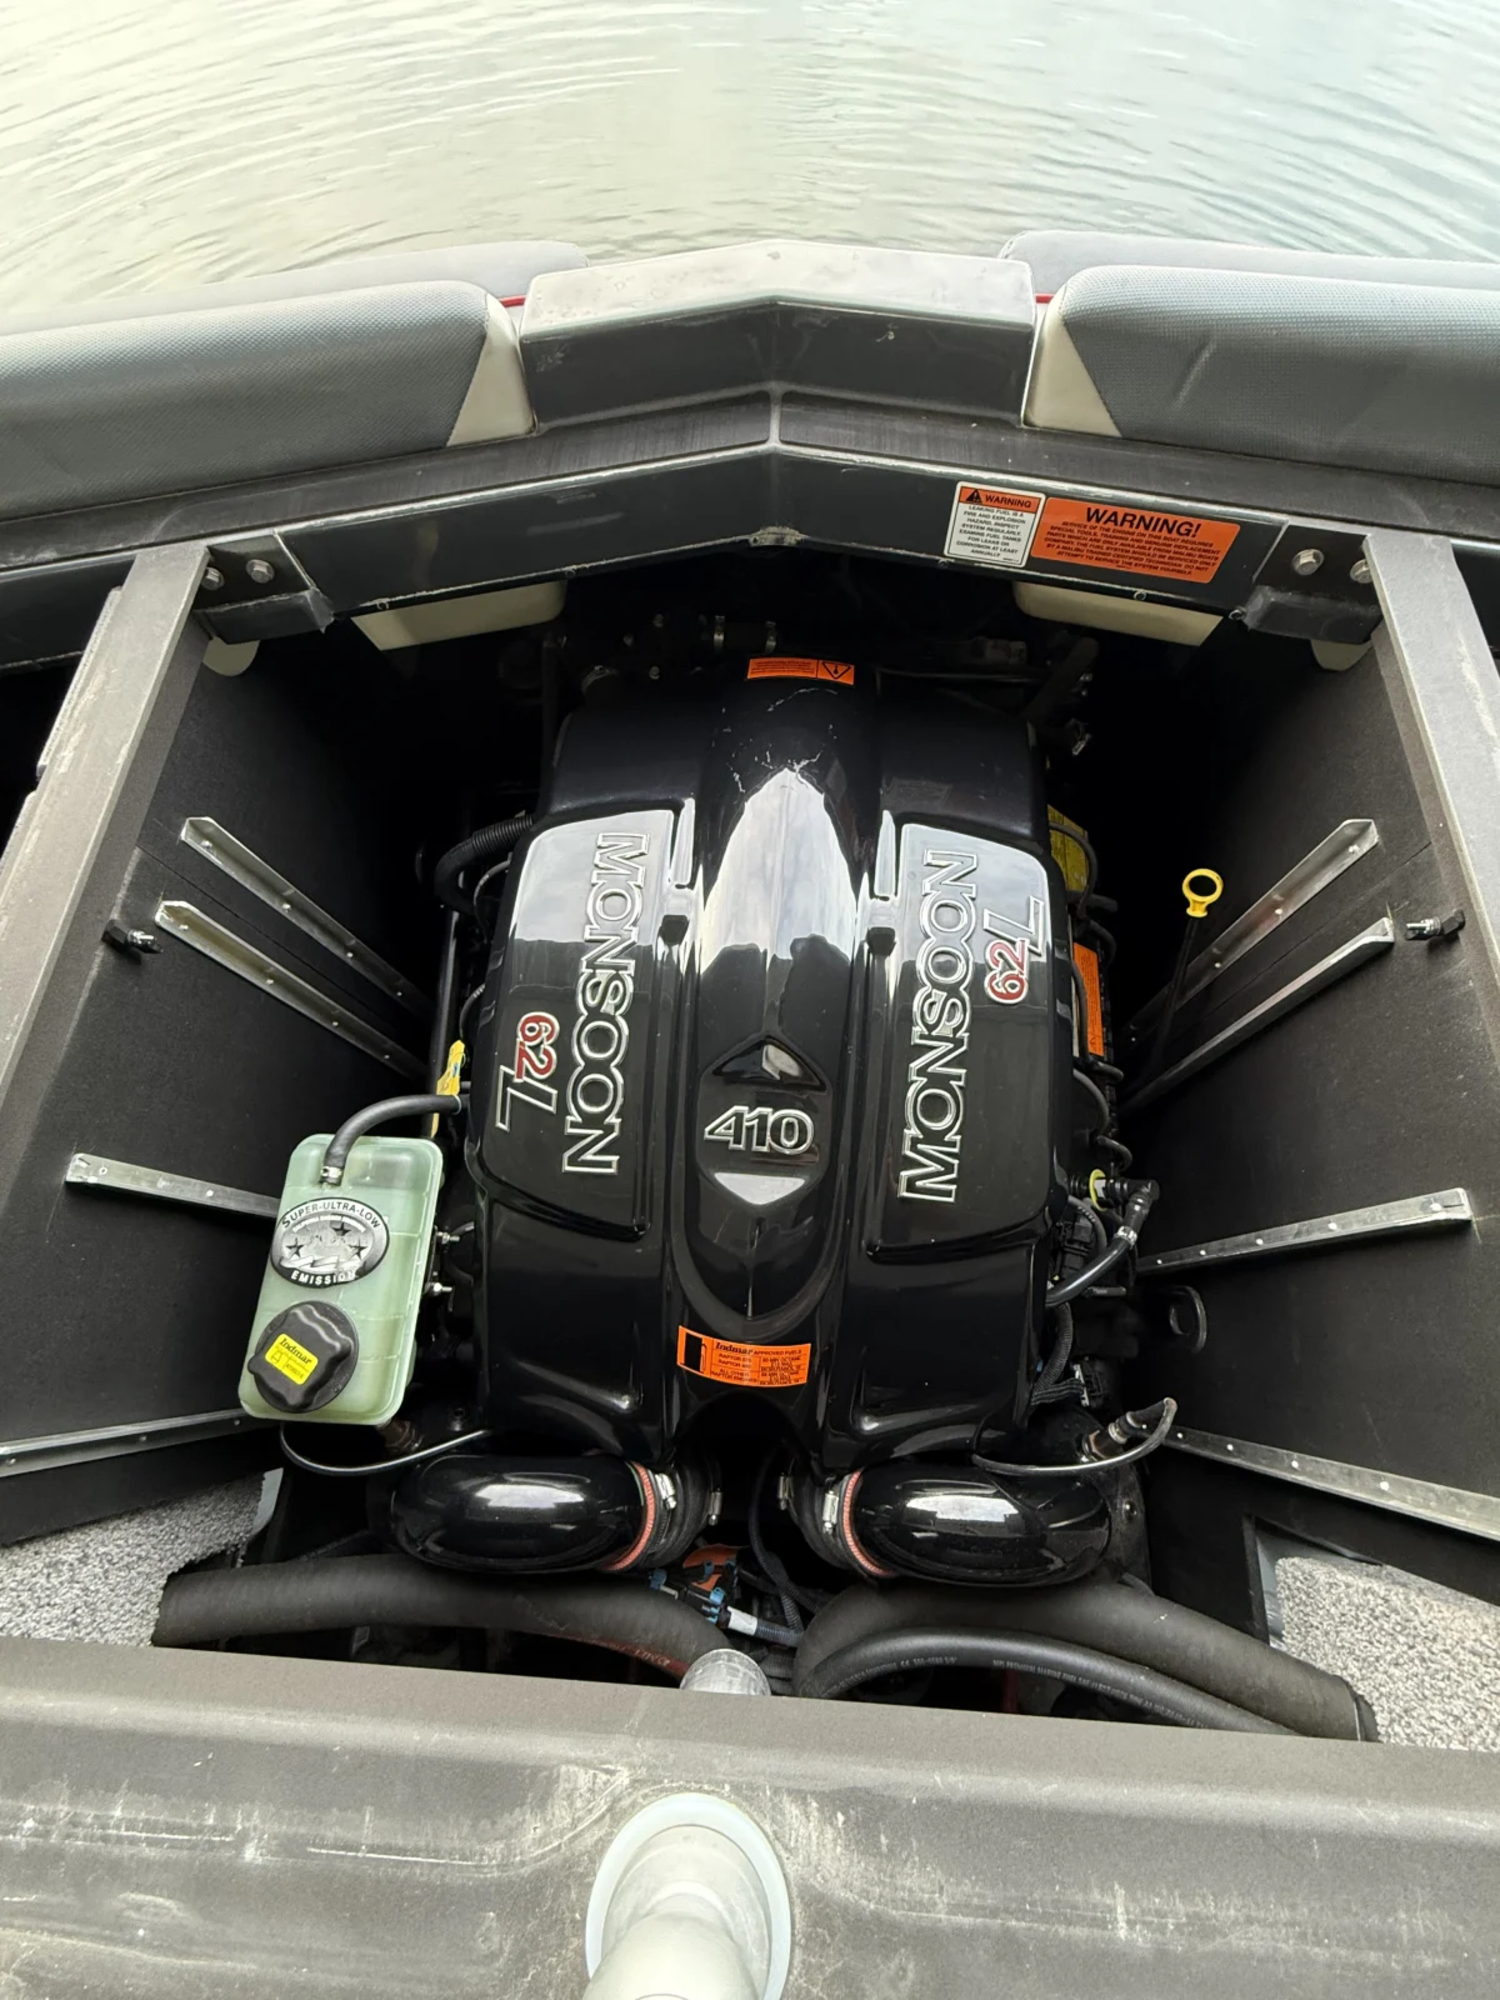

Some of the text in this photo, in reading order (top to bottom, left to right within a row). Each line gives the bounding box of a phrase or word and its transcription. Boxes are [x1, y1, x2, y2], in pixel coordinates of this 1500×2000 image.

[985, 494, 1031, 508] WARNING
[993, 515, 1025, 524] EXPLOSION
[1086, 507, 1202, 537] WARNING!
[957, 540, 990, 549] CORROSION
[1120, 542, 1151, 550] AVAILABLE
[1174, 544, 1220, 554] REPLACEMENT
[1181, 539, 1213, 547] REQUIRES
[1112, 553, 1144, 561] CERTIFIED
[562, 832, 649, 1175] MONSOON
[898, 849, 977, 1203] MONSOON
[704, 1105, 814, 1155] 410
[282, 1201, 381, 1228] SUPER-ULTRA-LOW
[280, 1338, 312, 1364] Indmar
[716, 1342, 753, 1355] Indmar
